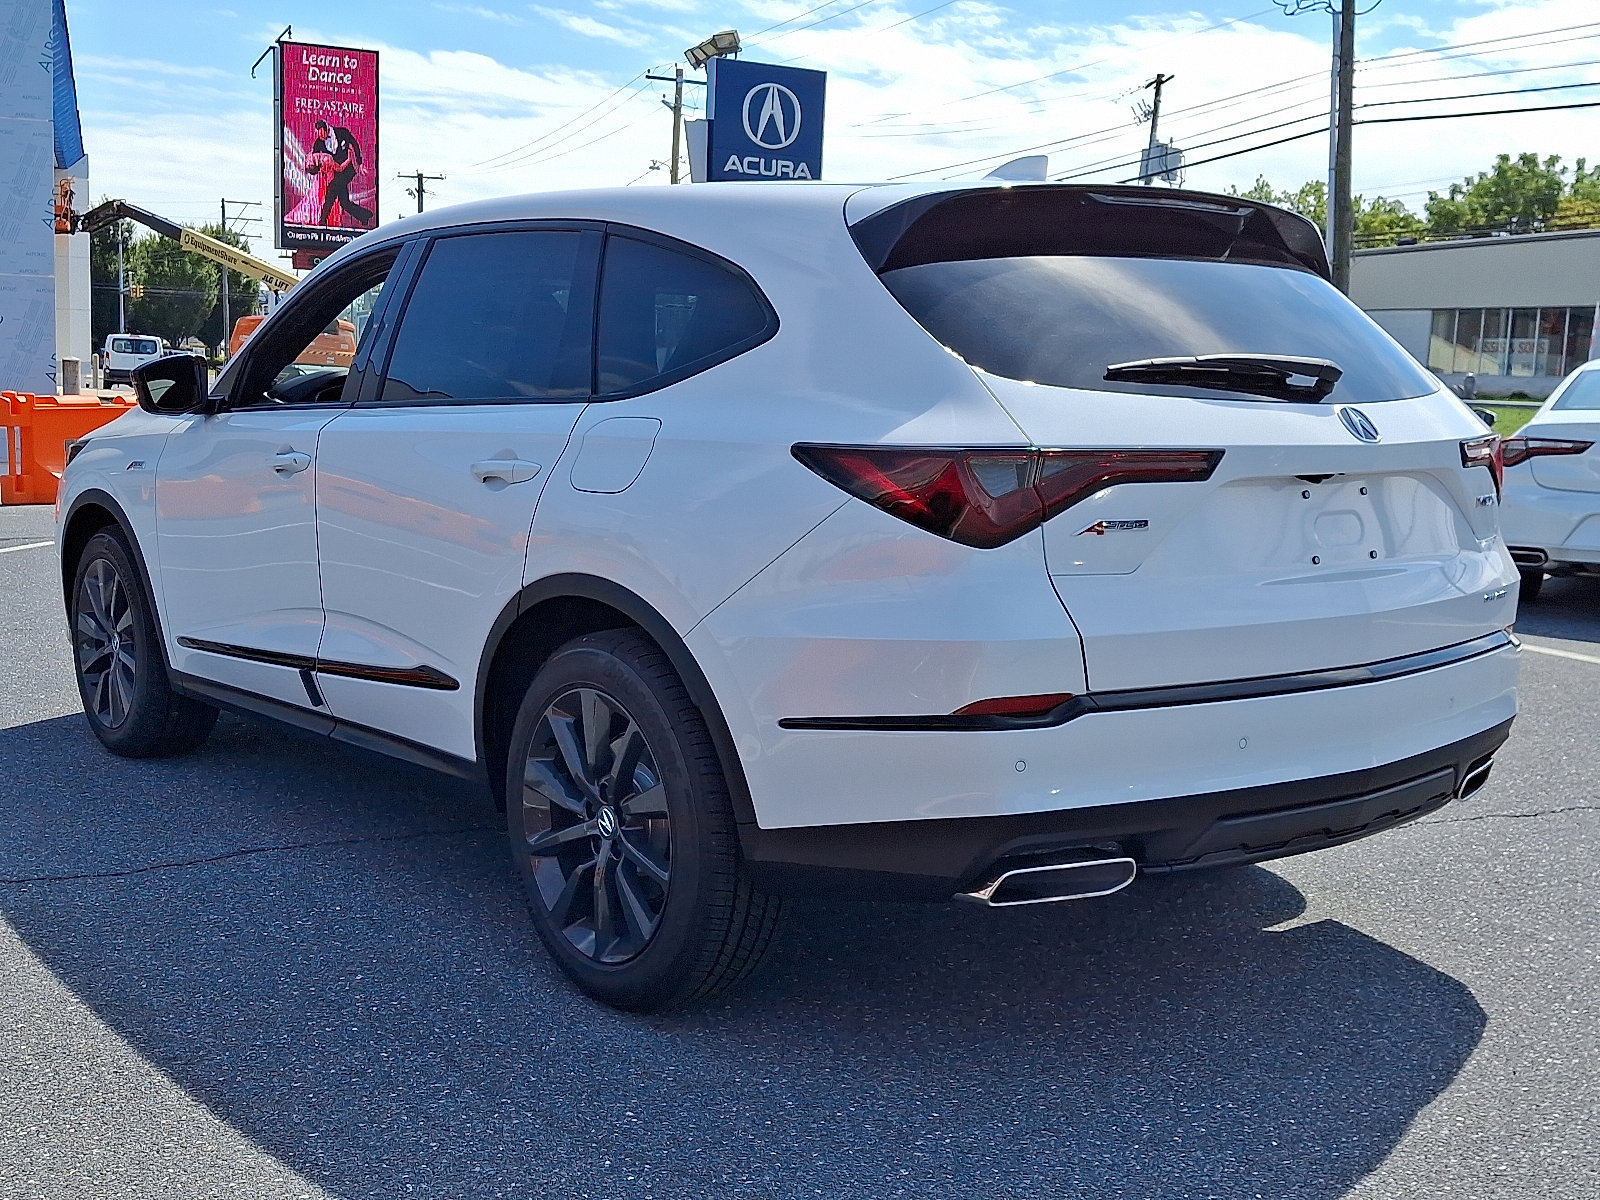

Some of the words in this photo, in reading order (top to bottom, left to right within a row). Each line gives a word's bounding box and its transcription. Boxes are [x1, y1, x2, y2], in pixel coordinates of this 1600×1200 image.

[302, 50, 340, 68] Learn
[343, 55, 358, 69] to
[308, 66, 352, 84] Dance
[295, 97, 321, 109] FRED
[323, 101, 365, 113] ASTAIRE
[723, 154, 812, 180] ACURA
[190, 237, 238, 266] EquipmentShare
[262, 273, 274, 284] JLG
[274, 279, 290, 291] LIFT
